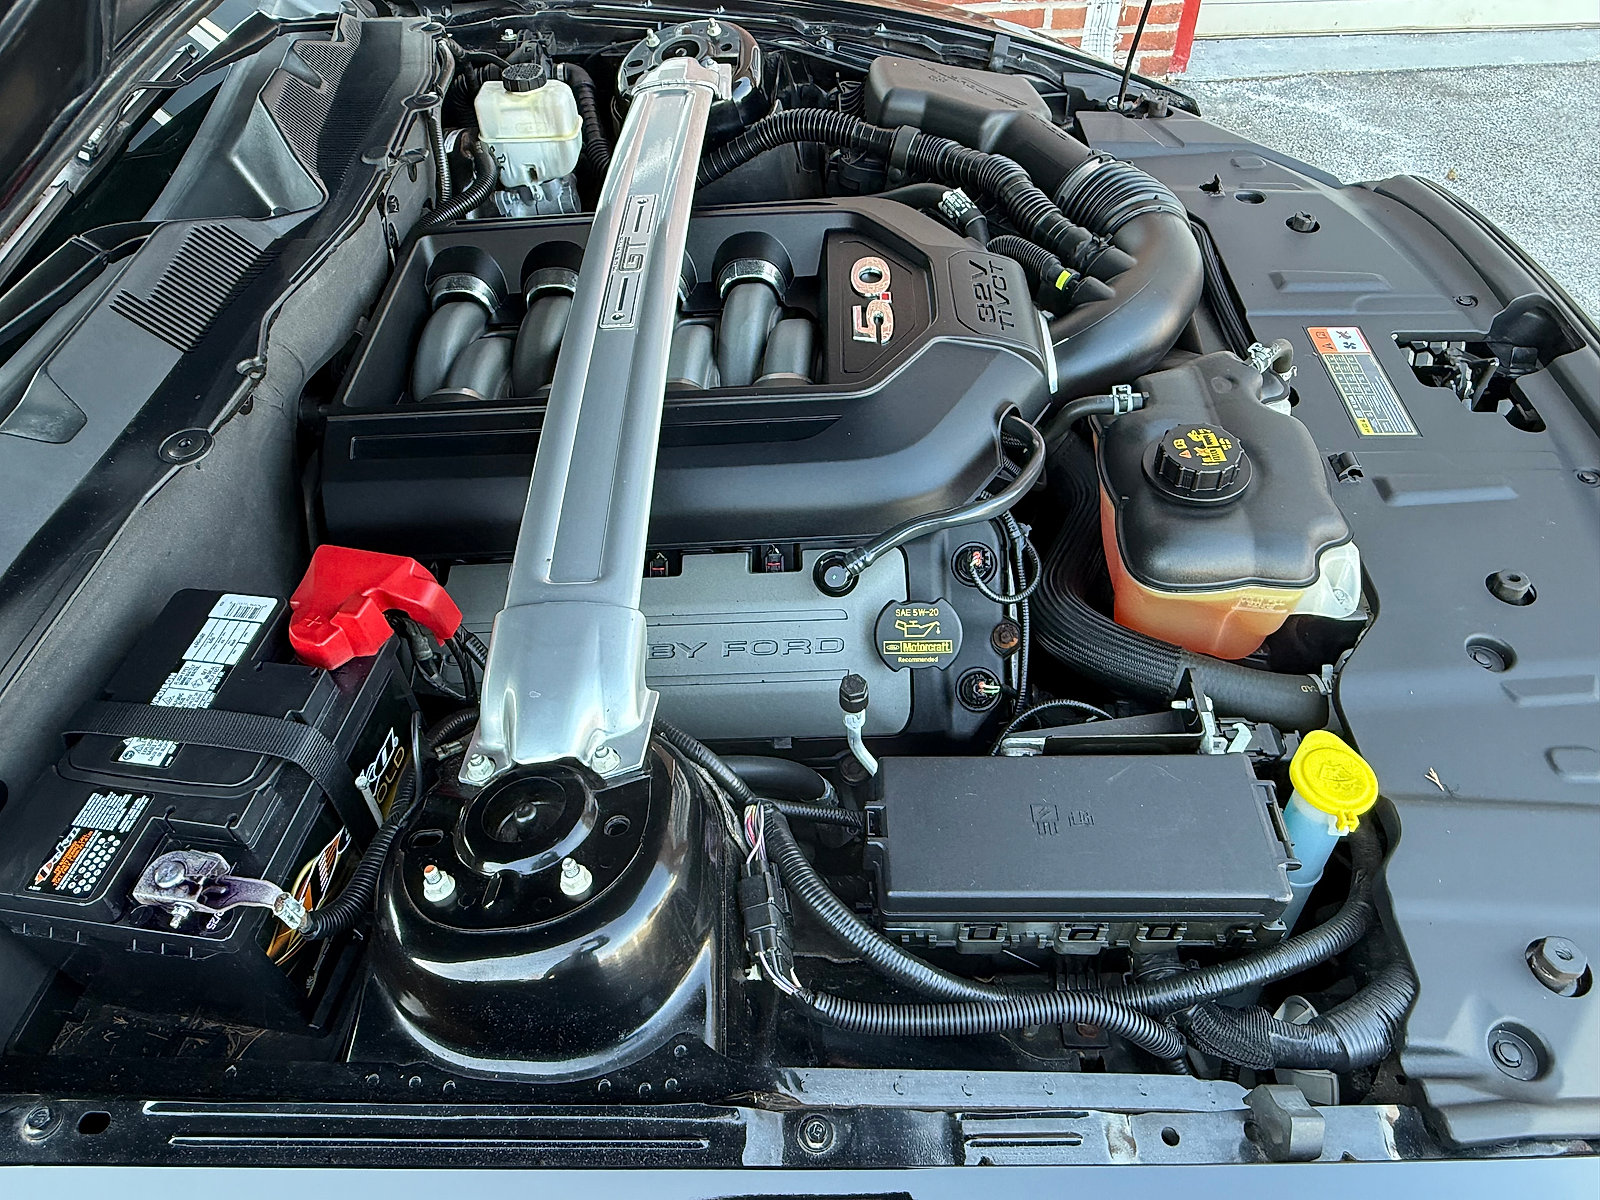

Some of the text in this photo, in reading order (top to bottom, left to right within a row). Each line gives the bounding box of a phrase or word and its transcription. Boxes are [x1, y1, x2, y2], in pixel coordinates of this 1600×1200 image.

[618, 236, 647, 273] GT
[850, 256, 894, 345] 5.0
[968, 258, 997, 324] 32V
[895, 607, 939, 617] SAE 5W-20
[647, 636, 846, 660] BY FORD
[897, 655, 939, 663] Recommended
[903, 641, 951, 653] Motorcraft
[377, 746, 405, 804] OLD
